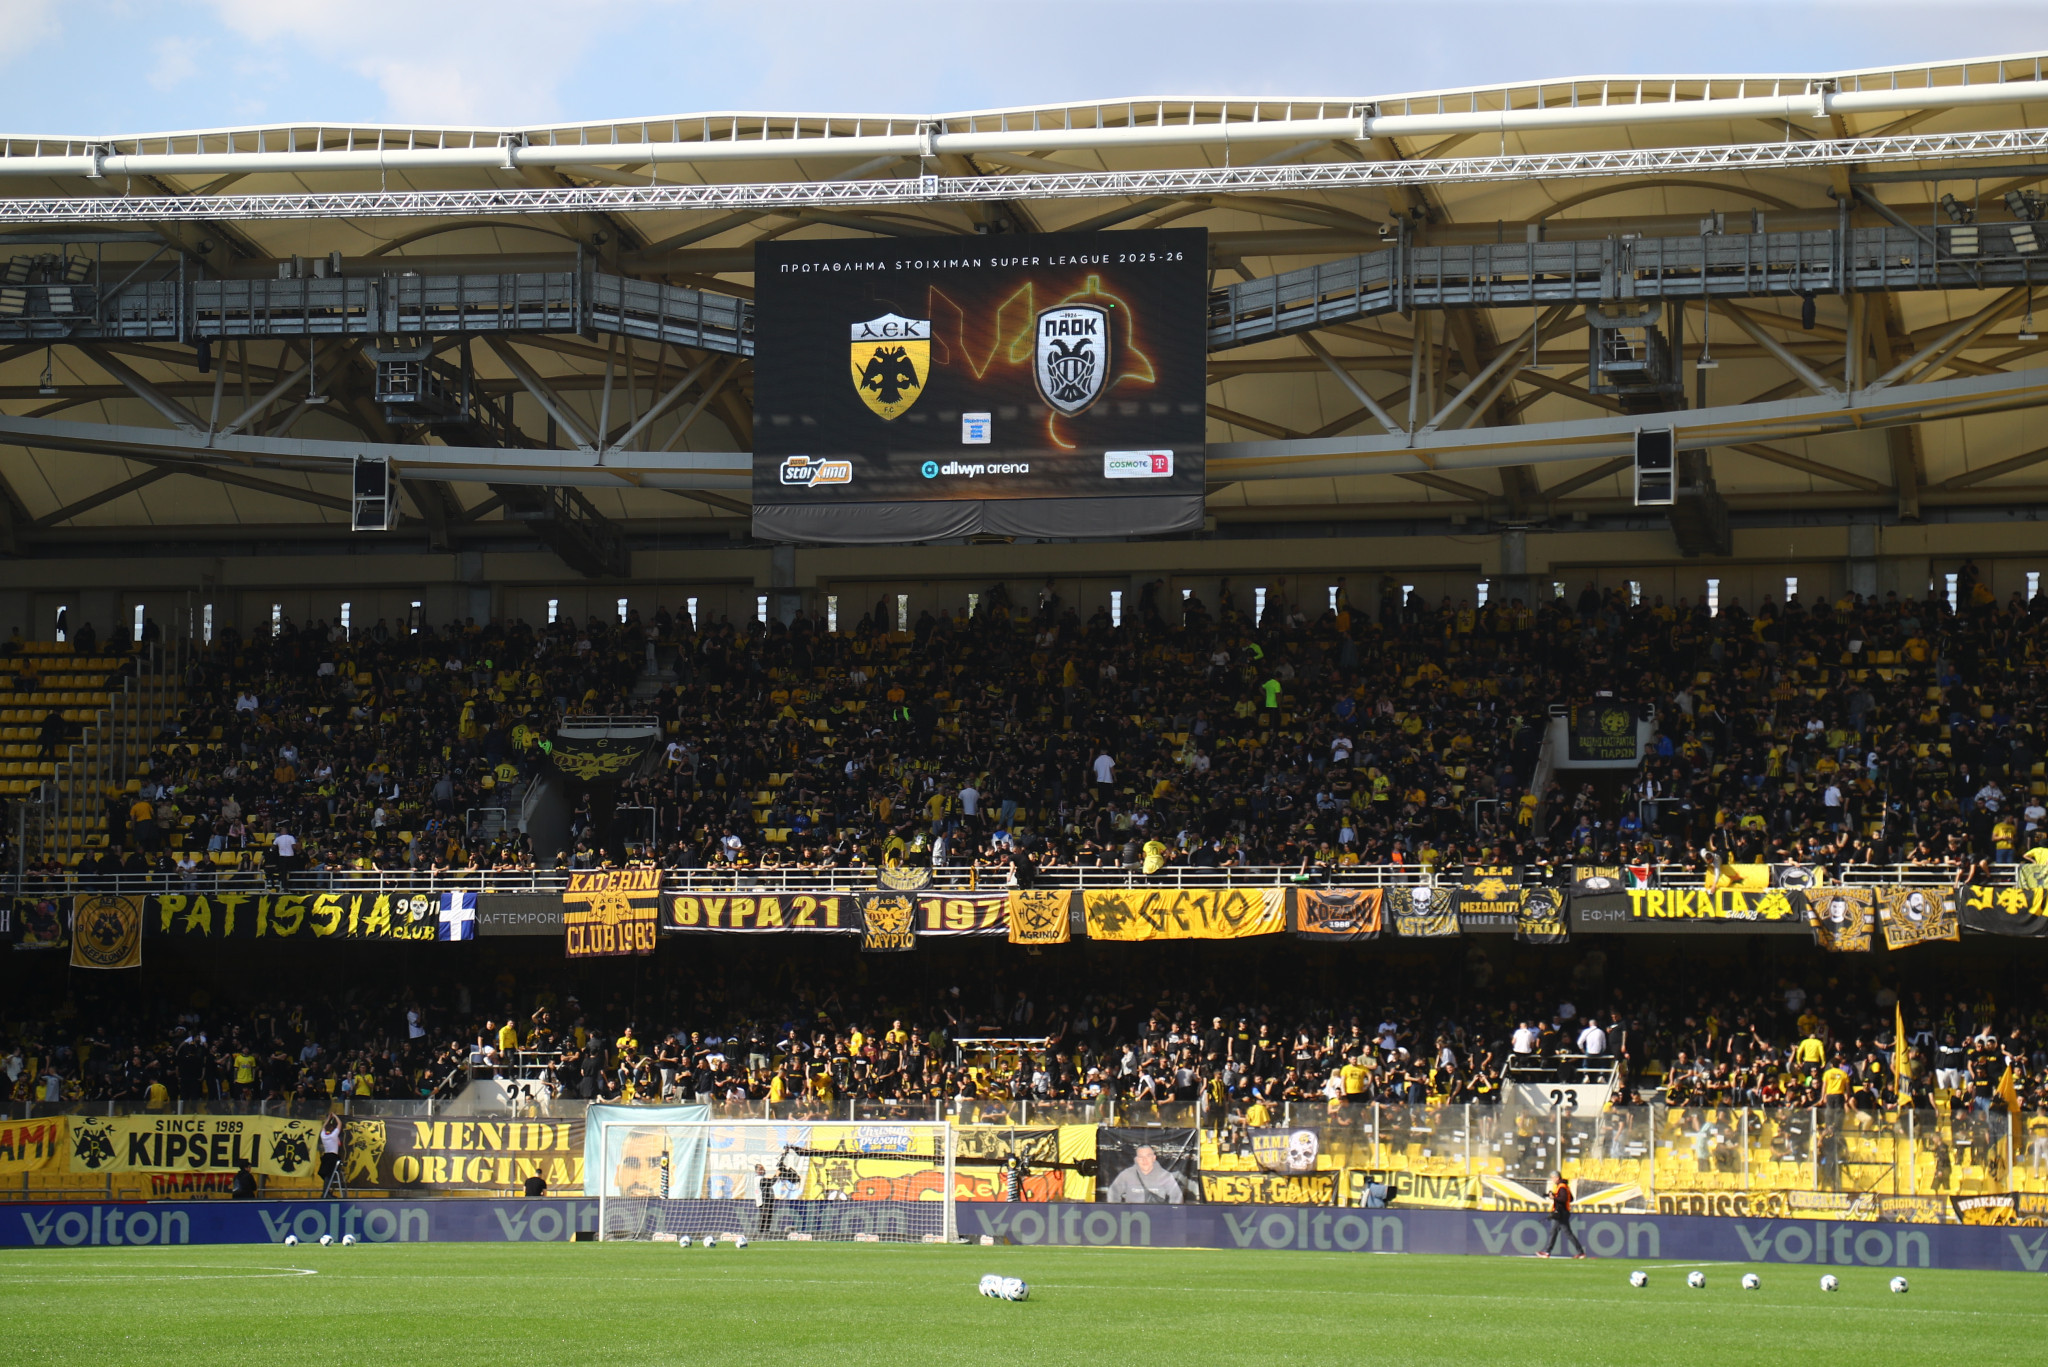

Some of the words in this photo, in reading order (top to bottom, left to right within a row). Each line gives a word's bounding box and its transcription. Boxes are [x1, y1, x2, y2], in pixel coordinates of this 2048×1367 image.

[781, 261, 886, 273] ΠΡΩΤΑΘΛΗΜΑ
[895, 258, 981, 270] STOIXIMAN
[991, 256, 1040, 267] SUPER
[1050, 254, 1110, 265] LEAGUE
[1119, 252, 1184, 263] 2025-26
[941, 462, 985, 478] allwyn
[987, 463, 1029, 474] arena
[502, 768, 511, 779] 13
[569, 869, 662, 892] KATERINI
[155, 893, 391, 938] PATISSIA
[793, 896, 839, 927] 21
[1626, 889, 1749, 919] TRIKALA
[568, 924, 615, 955] CLUB
[617, 922, 657, 952] 1983
[865, 933, 914, 949] ΛΑΥΡΙΟ
[1020, 930, 1060, 940] AGRINIO
[1892, 925, 1950, 941] ΠΑΡΩΝ
[506, 1084, 531, 1100] 21
[1550, 1089, 1578, 1109] 23
[155, 1120, 205, 1132] SINCE
[215, 1121, 243, 1133] 1989
[413, 1121, 572, 1150] MENIDI
[128, 1132, 261, 1168] KIPSELI
[1201, 1175, 1265, 1203] WEST
[1269, 1176, 1333, 1204] GANG
[1882, 1198, 1928, 1211] ORIGINAL
[1932, 1202, 1943, 1212] 21
[21, 1206, 190, 1246] volton
[258, 1203, 429, 1245] volton
[975, 1204, 1150, 1246] volton
[1223, 1208, 1404, 1251] volton
[1735, 1221, 1930, 1267] volton
